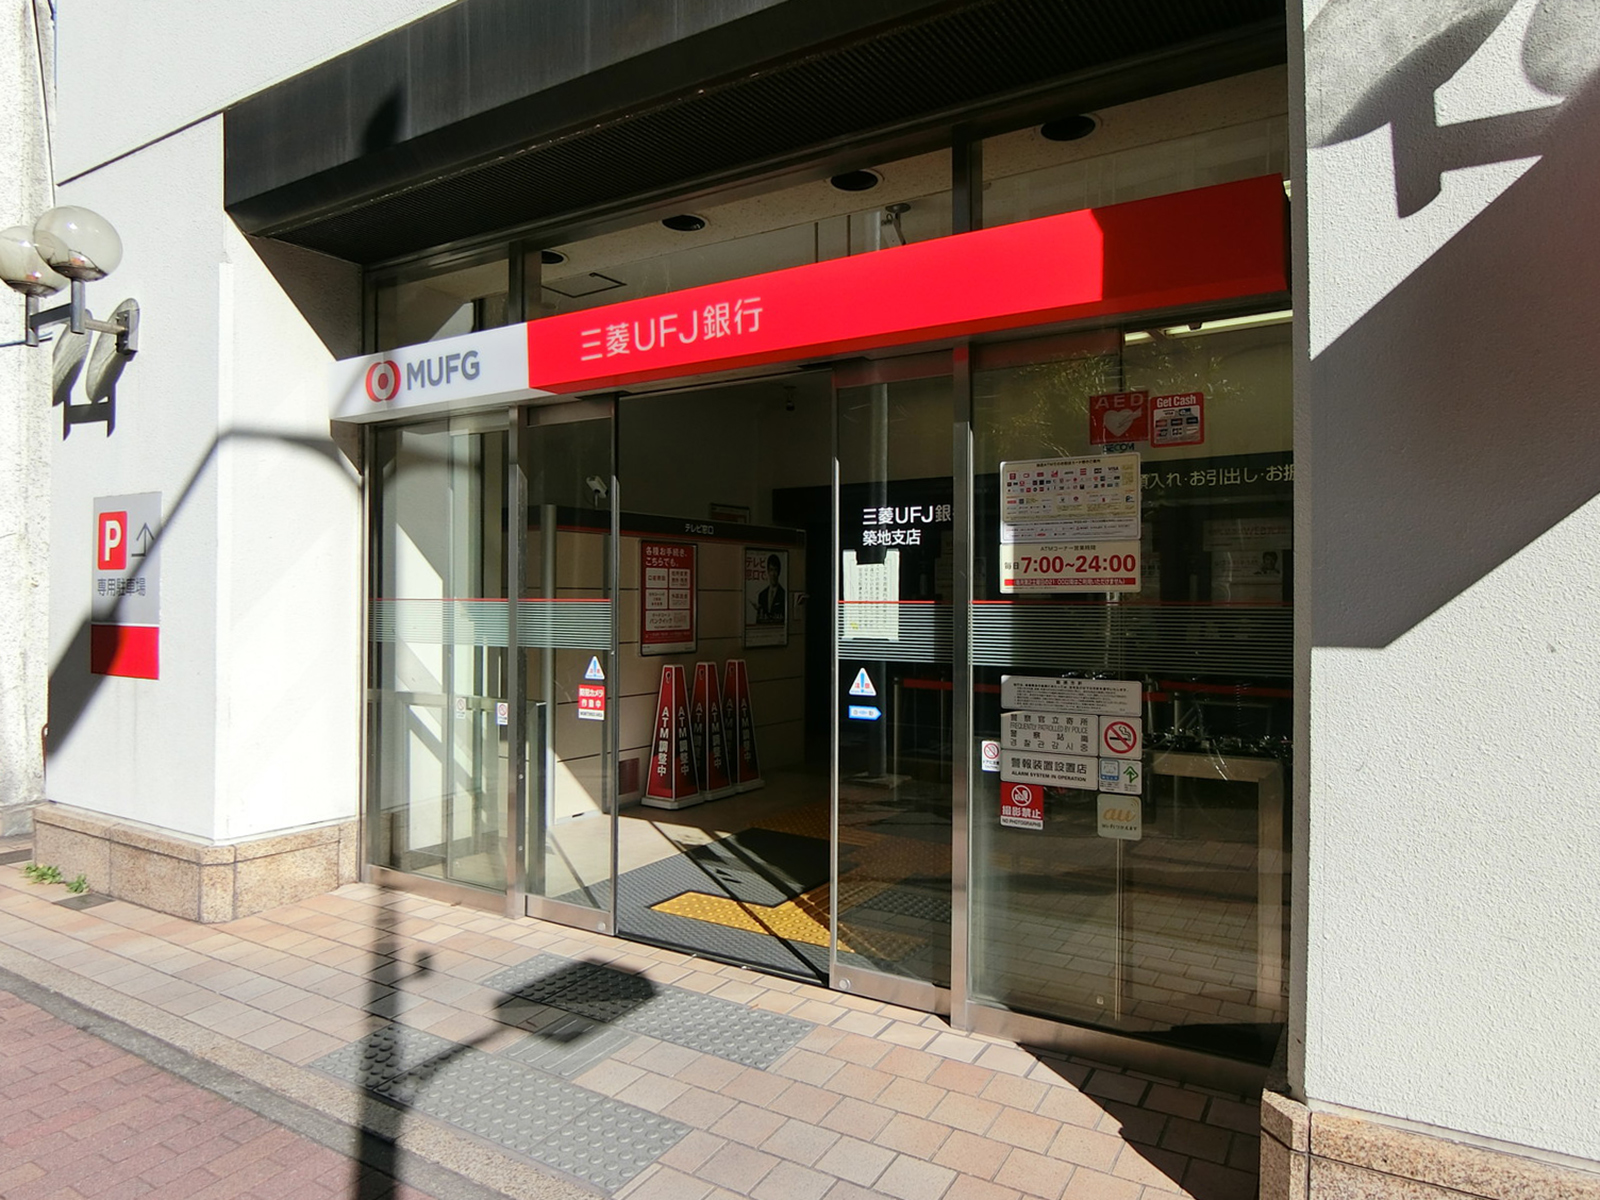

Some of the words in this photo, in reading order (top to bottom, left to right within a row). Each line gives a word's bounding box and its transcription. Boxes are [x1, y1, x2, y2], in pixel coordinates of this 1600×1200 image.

[580, 297, 764, 362] 三菱UFJ銀行
[406, 350, 480, 391] MUFG
[1095, 393, 1144, 409] AED
[1156, 397, 1172, 408] Get
[1173, 395, 1196, 406] Cash
[862, 504, 954, 526] 三菱UFJ銀
[684, 523, 714, 535] テレビ窓口
[862, 529, 921, 546] 築地支店
[104, 520, 122, 561] P
[97, 578, 146, 597] 専用駐車場
[1010, 714, 1088, 726] 警察官立寄所
[1010, 722, 1037, 730] FREQUENTLY
[1038, 724, 1064, 732] PATROLLED
[1064, 725, 1071, 733] BY
[1071, 725, 1088, 734] POLICE
[657, 706, 670, 777] ATM調整中
[678, 706, 690, 776] ATM調整中
[1011, 757, 1087, 775] 警報装置設置店
[1002, 805, 1042, 819] 撮影禁止
[1103, 808, 1137, 822] au
